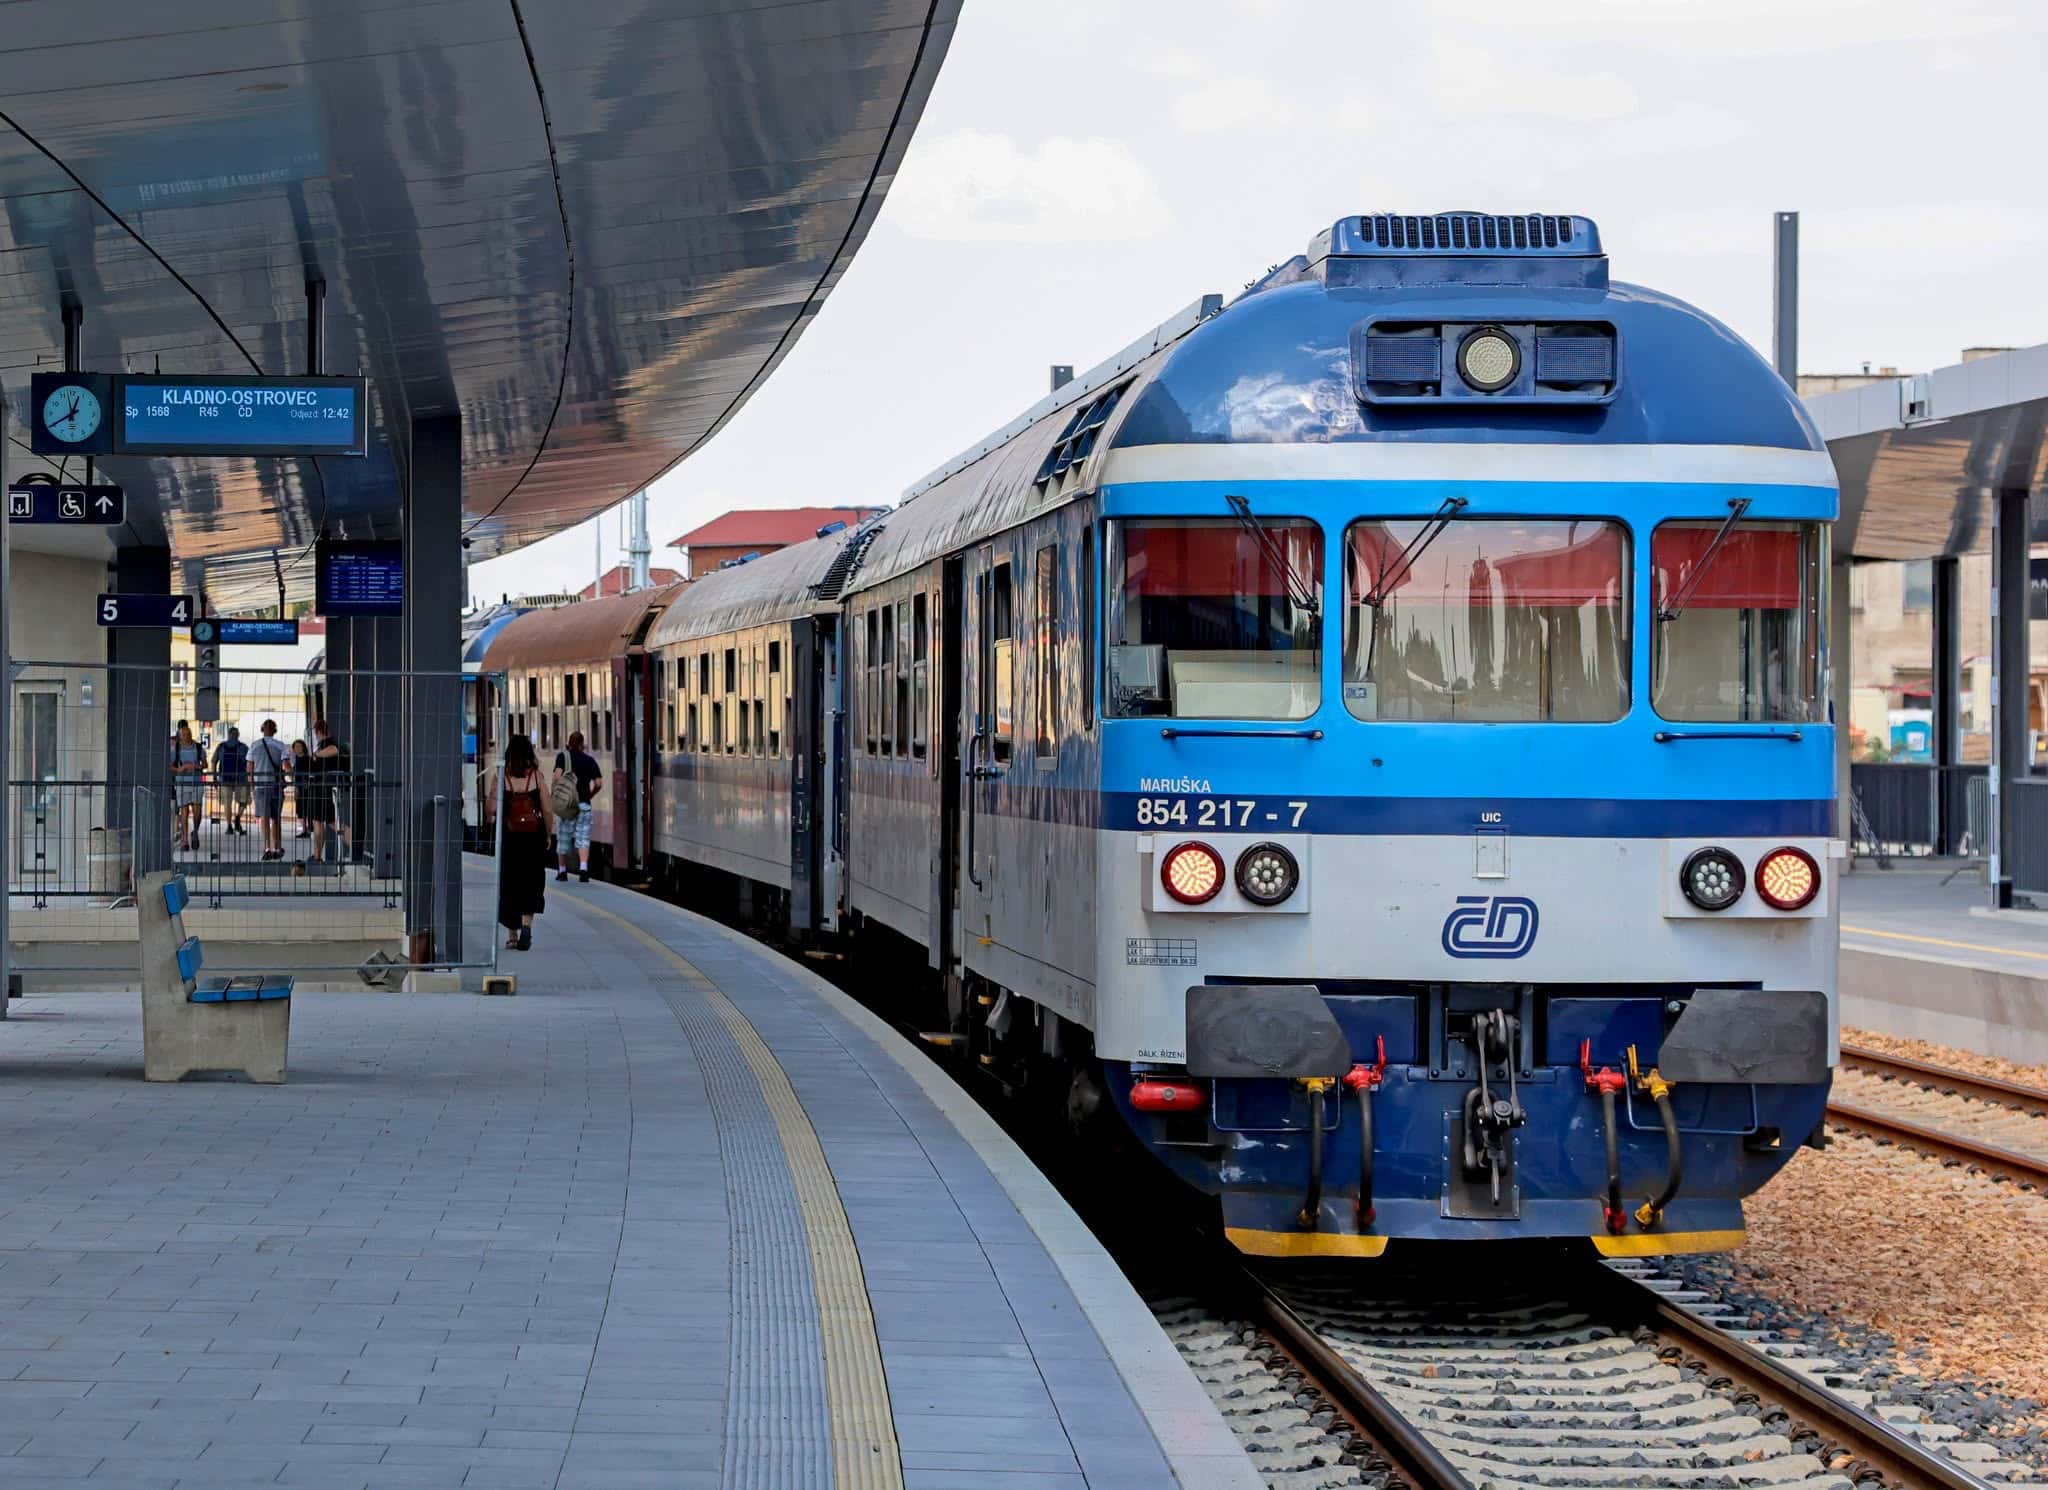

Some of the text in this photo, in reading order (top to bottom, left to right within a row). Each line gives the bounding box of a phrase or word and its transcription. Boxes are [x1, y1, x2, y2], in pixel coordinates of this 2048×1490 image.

[162, 389, 317, 405] KLADNO-OSTROVEC
[125, 406, 139, 418] Sp
[146, 406, 170, 417] 1568
[199, 406, 219, 417] R45
[238, 404, 253, 417] ČD
[322, 407, 349, 418] 12:42
[103, 600, 188, 622] 5 4
[1140, 776, 1212, 793] MARUŠKA
[1136, 798, 1188, 825] 854
[1198, 800, 1256, 827] 217
[1288, 801, 1308, 828] 7
[1481, 812, 1502, 823] UIC
